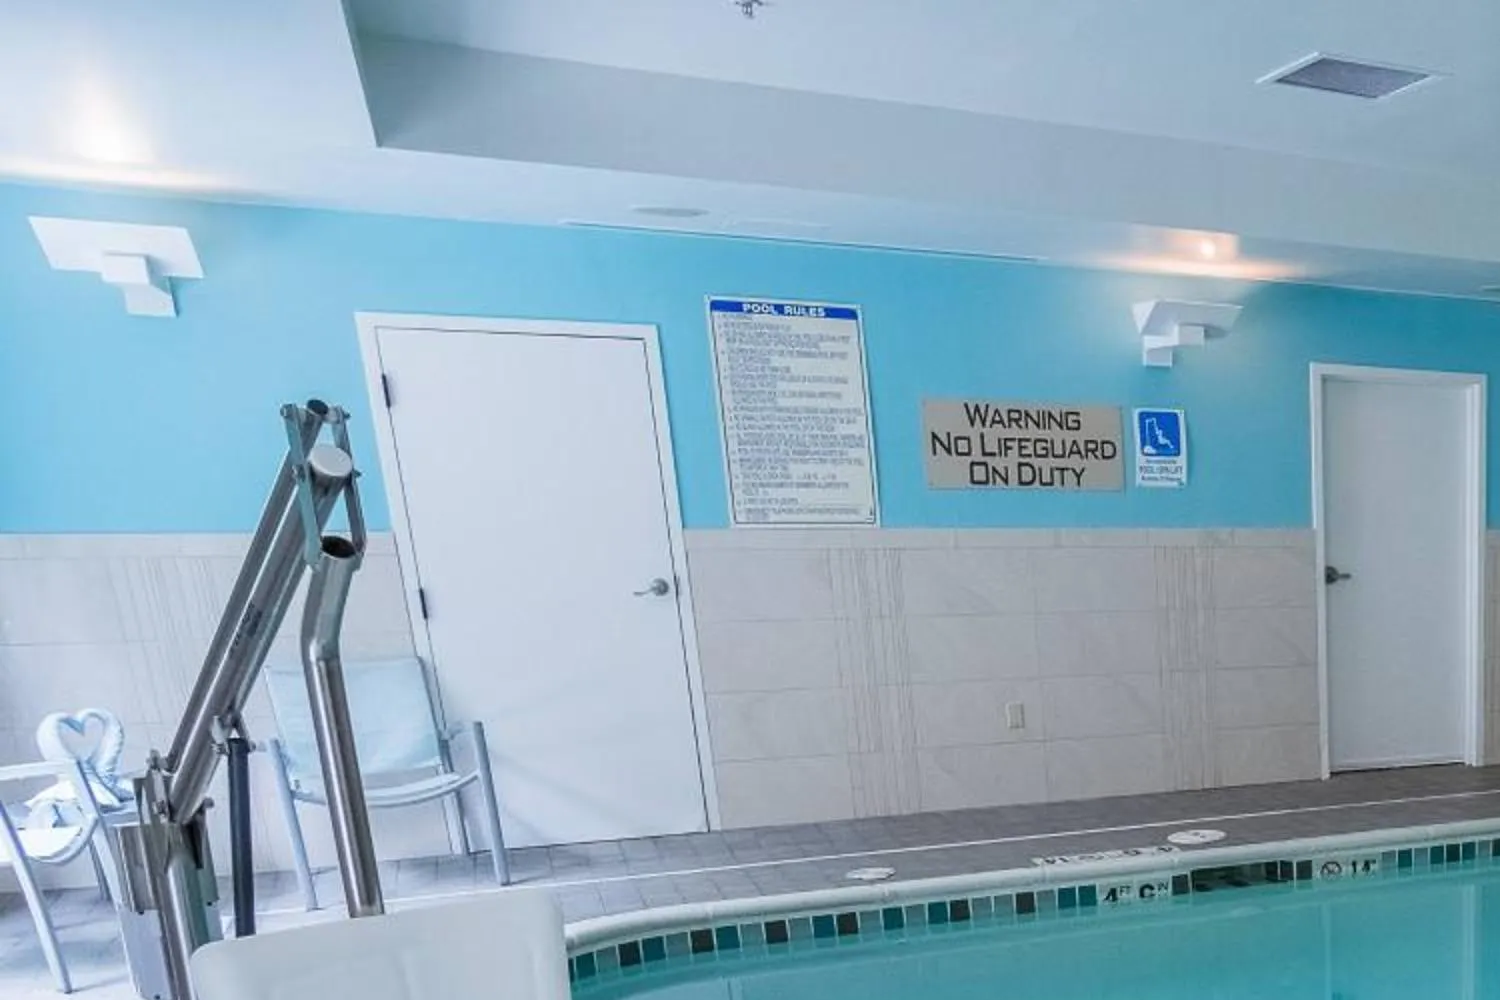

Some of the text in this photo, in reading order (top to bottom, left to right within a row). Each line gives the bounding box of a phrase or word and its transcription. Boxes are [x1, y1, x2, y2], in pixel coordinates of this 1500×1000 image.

[742, 303, 826, 318] POOL RULES
[963, 402, 1082, 431] WARNING
[930, 431, 1118, 461] NO LIFEGUARD
[968, 460, 1086, 487] ON DUTY
